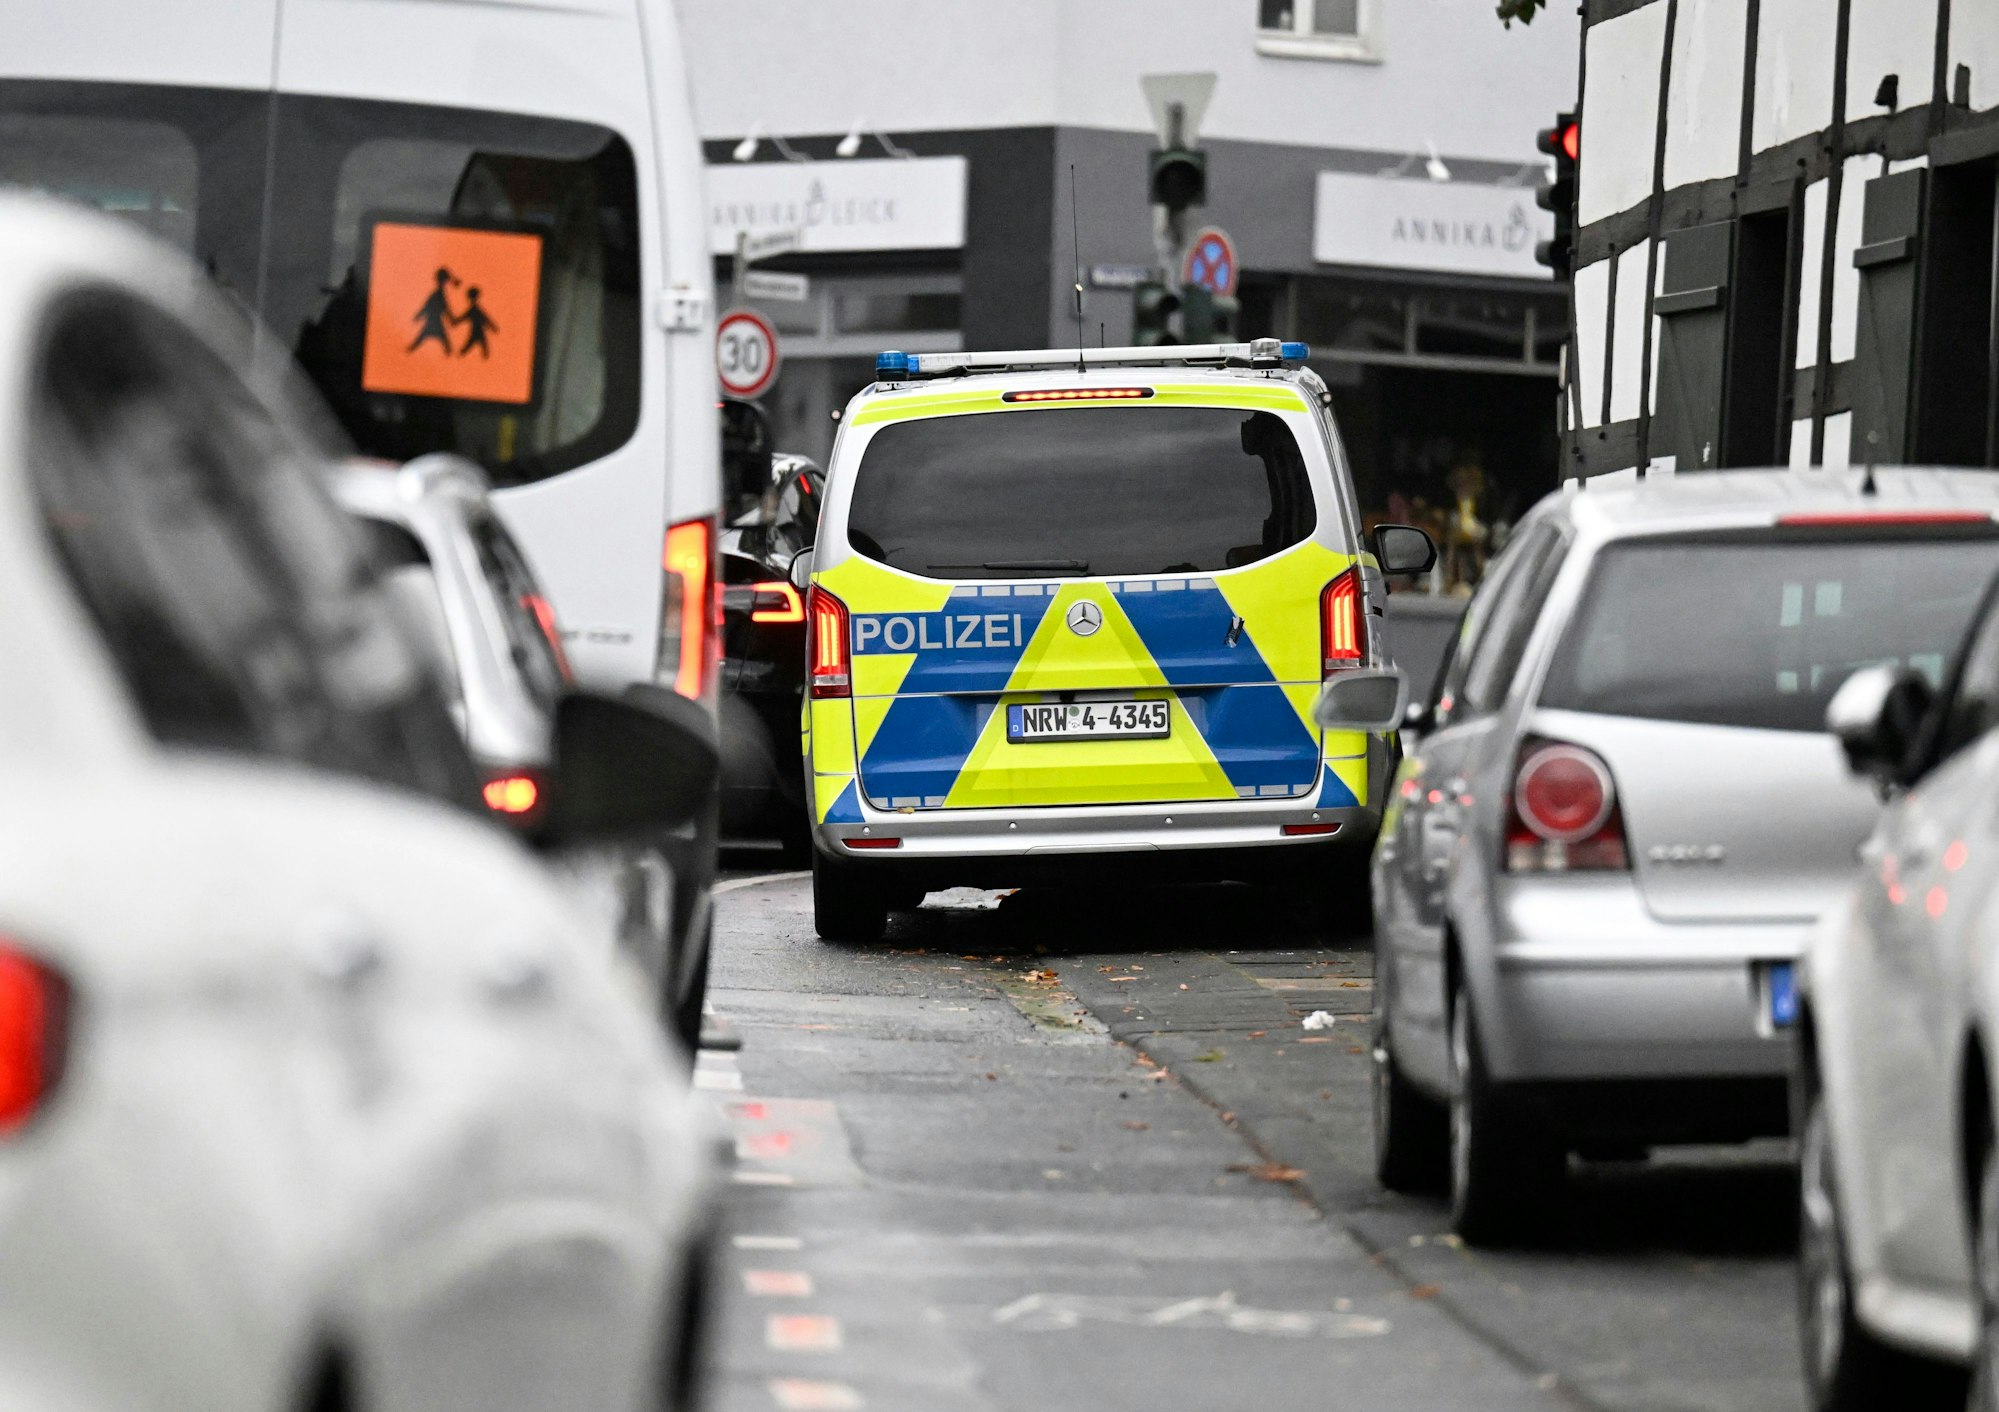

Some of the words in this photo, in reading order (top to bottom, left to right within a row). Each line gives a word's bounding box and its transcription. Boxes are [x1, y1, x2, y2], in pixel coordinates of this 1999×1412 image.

[713, 201, 798, 225] ANNIKA
[1392, 217, 1495, 248] ANNIKA
[725, 334, 762, 374] 30
[856, 613, 1022, 651] POLIZEI
[1012, 724, 1019, 732] D
[1023, 707, 1068, 732] NRW
[1082, 704, 1166, 731] 4-4345
